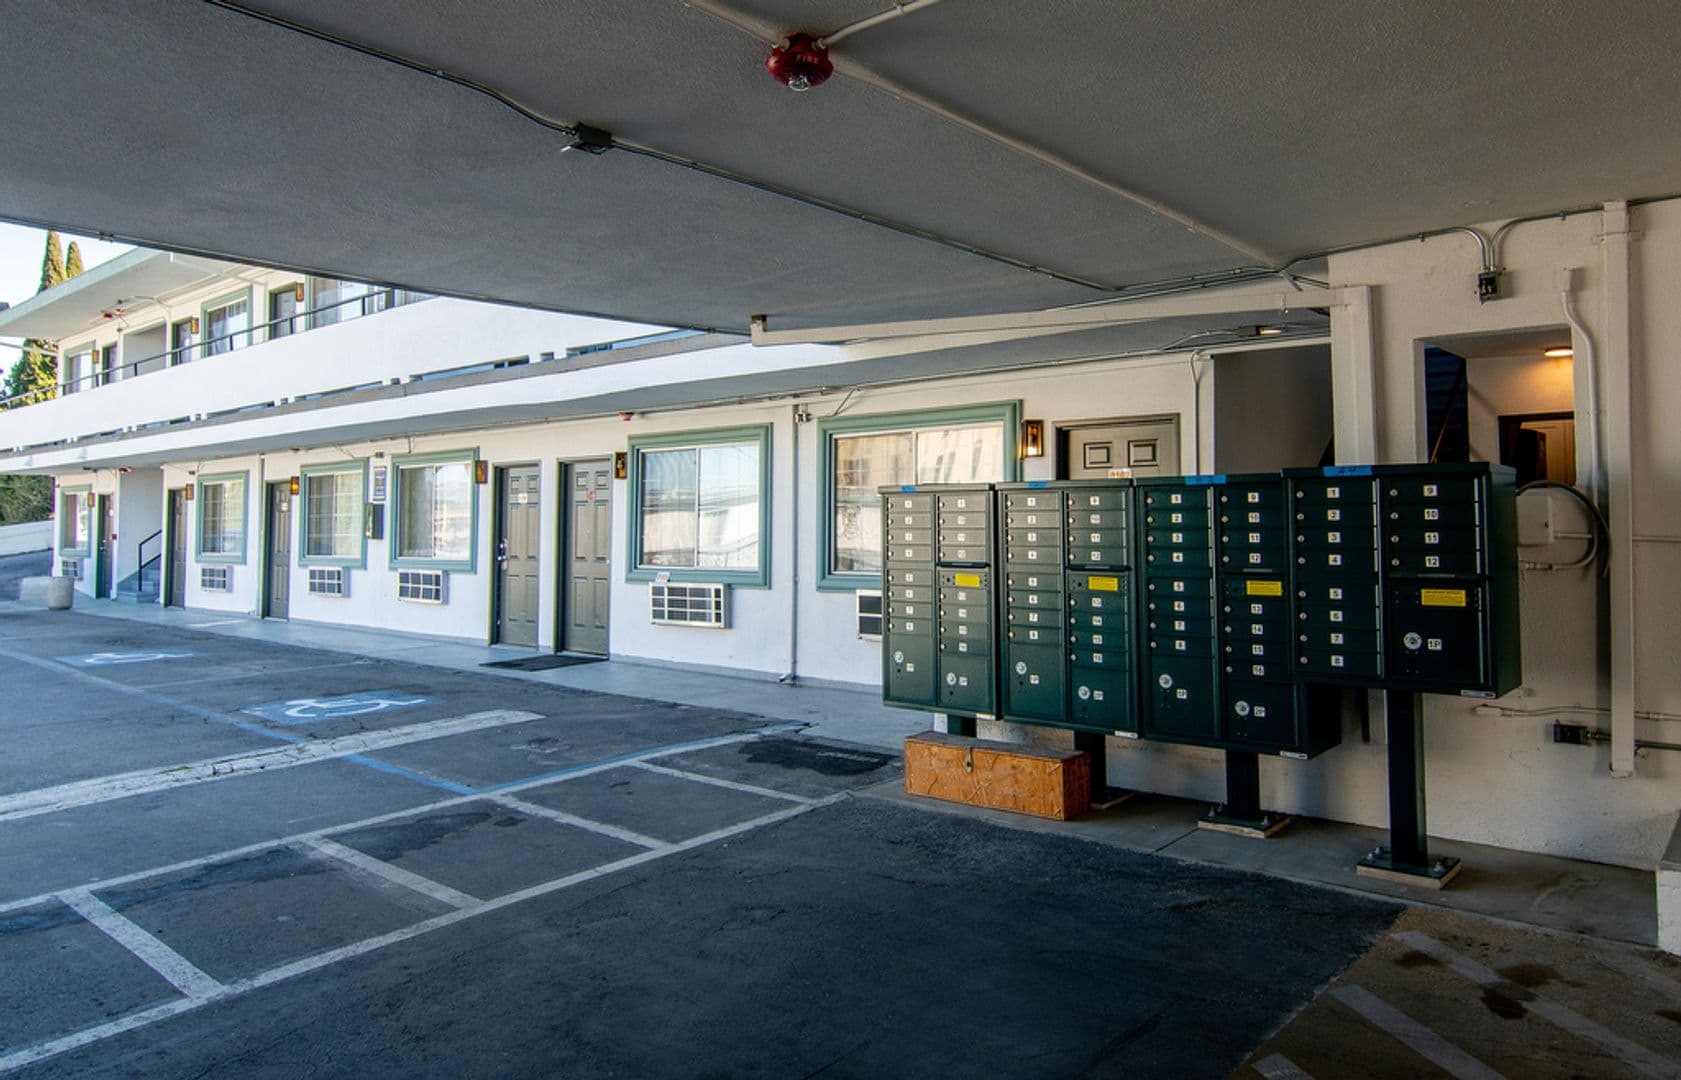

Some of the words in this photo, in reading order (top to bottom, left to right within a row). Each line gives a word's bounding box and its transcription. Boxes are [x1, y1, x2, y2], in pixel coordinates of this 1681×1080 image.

[1250, 514, 1259, 522] 10
[1426, 510, 1437, 518] 10
[1250, 534, 1259, 542] 11
[1426, 534, 1437, 542] 11
[1251, 554, 1260, 562] 12
[1427, 558, 1438, 566] 12
[1253, 625, 1262, 633] 14
[1429, 640, 1440, 648] 1P
